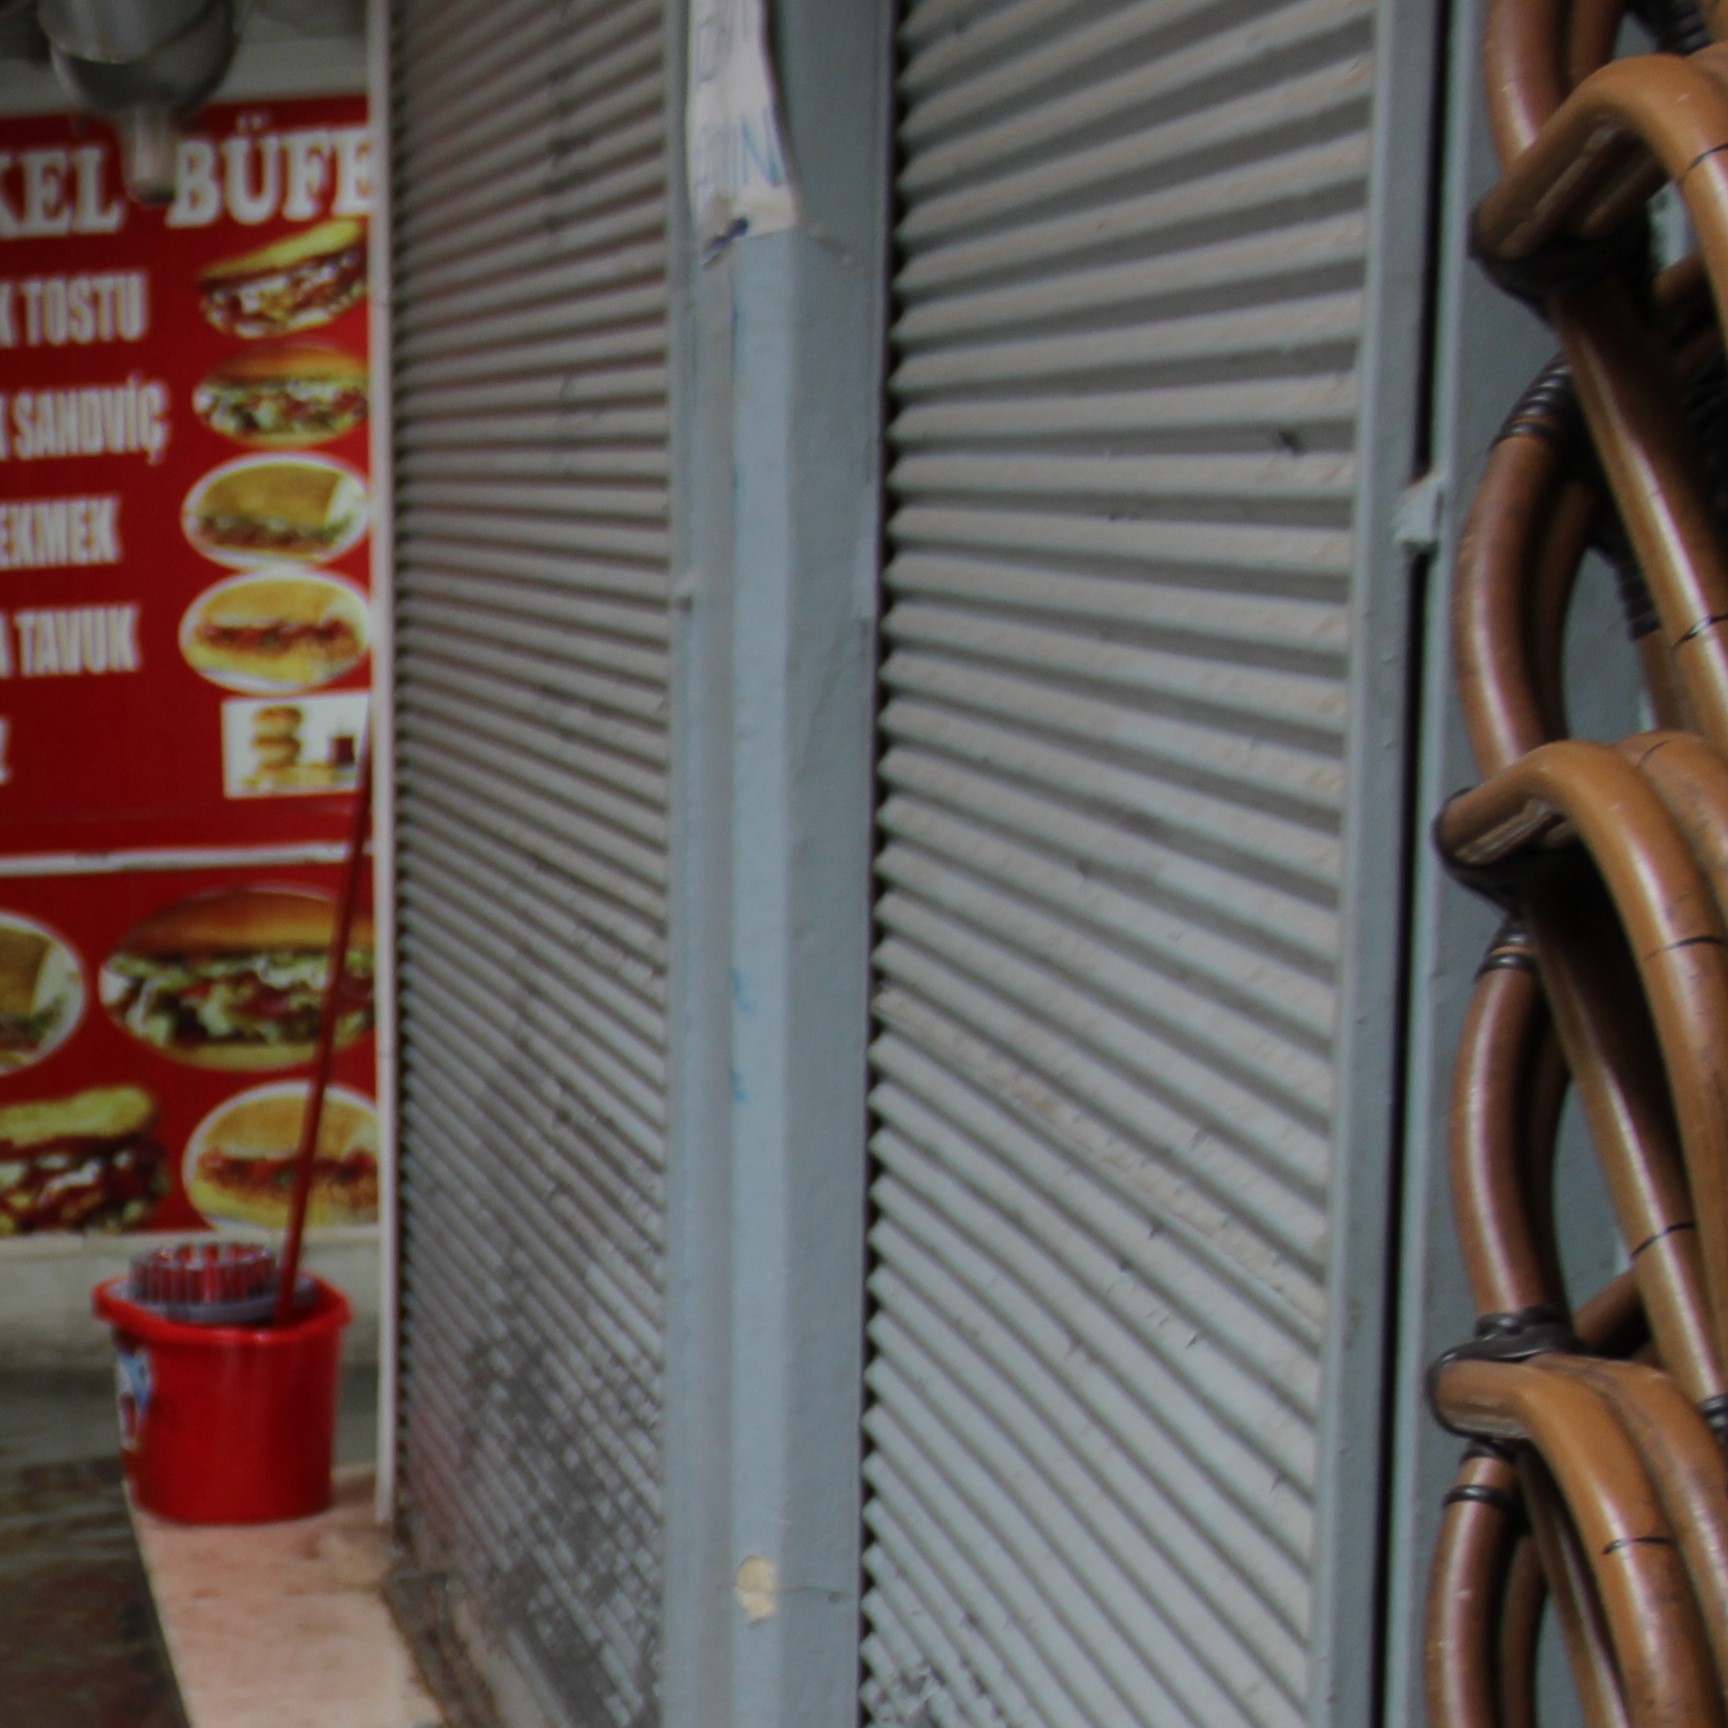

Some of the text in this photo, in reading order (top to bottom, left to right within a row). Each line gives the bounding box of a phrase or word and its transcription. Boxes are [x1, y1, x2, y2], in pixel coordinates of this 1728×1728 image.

[19, 271, 149, 346] TOSTU
[13, 372, 168, 464] SANDVİÇ
[13, 605, 141, 677] TAVUK
